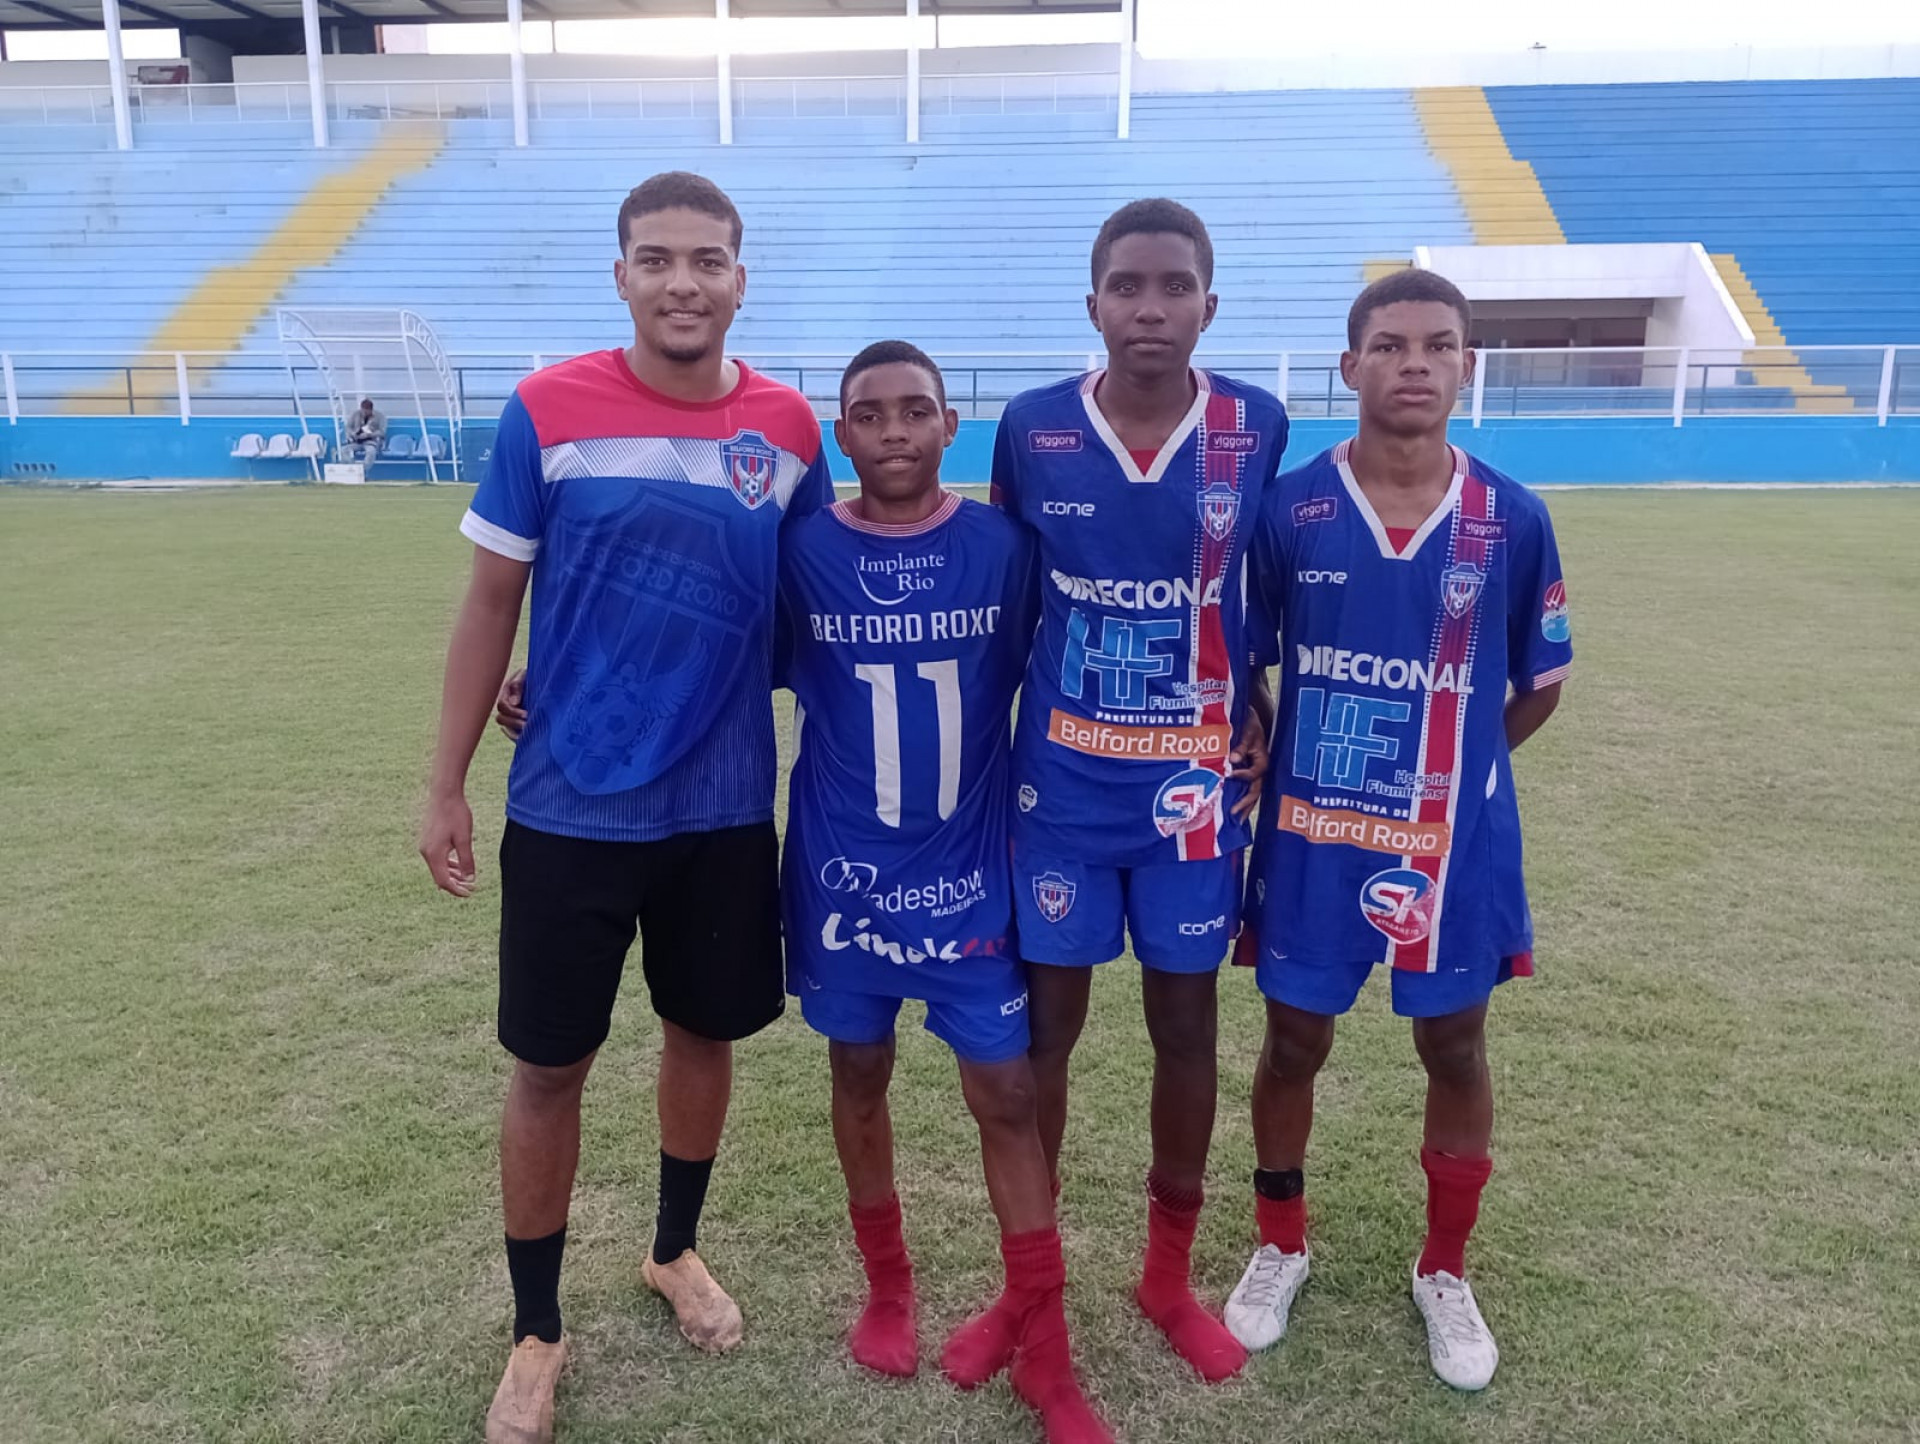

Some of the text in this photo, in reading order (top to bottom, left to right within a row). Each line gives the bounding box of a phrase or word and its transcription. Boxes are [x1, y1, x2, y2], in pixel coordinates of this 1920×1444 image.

[1035, 435, 1076, 449] viggore
[1214, 436, 1254, 449] viggore
[1297, 502, 1331, 518] vigore
[1464, 521, 1502, 537] viggore
[859, 553, 945, 573] Implante
[896, 573, 935, 591] Rio
[809, 613, 922, 644] BELFORD
[1296, 643, 1474, 694] DIRECIONAL
[1096, 711, 1194, 724] PREFEITURA DE
[854, 658, 962, 829] 11
[1060, 719, 1220, 755] Belford Roxo
[1392, 808, 1411, 819] DE
[1291, 805, 1438, 851] Blford Roxo
